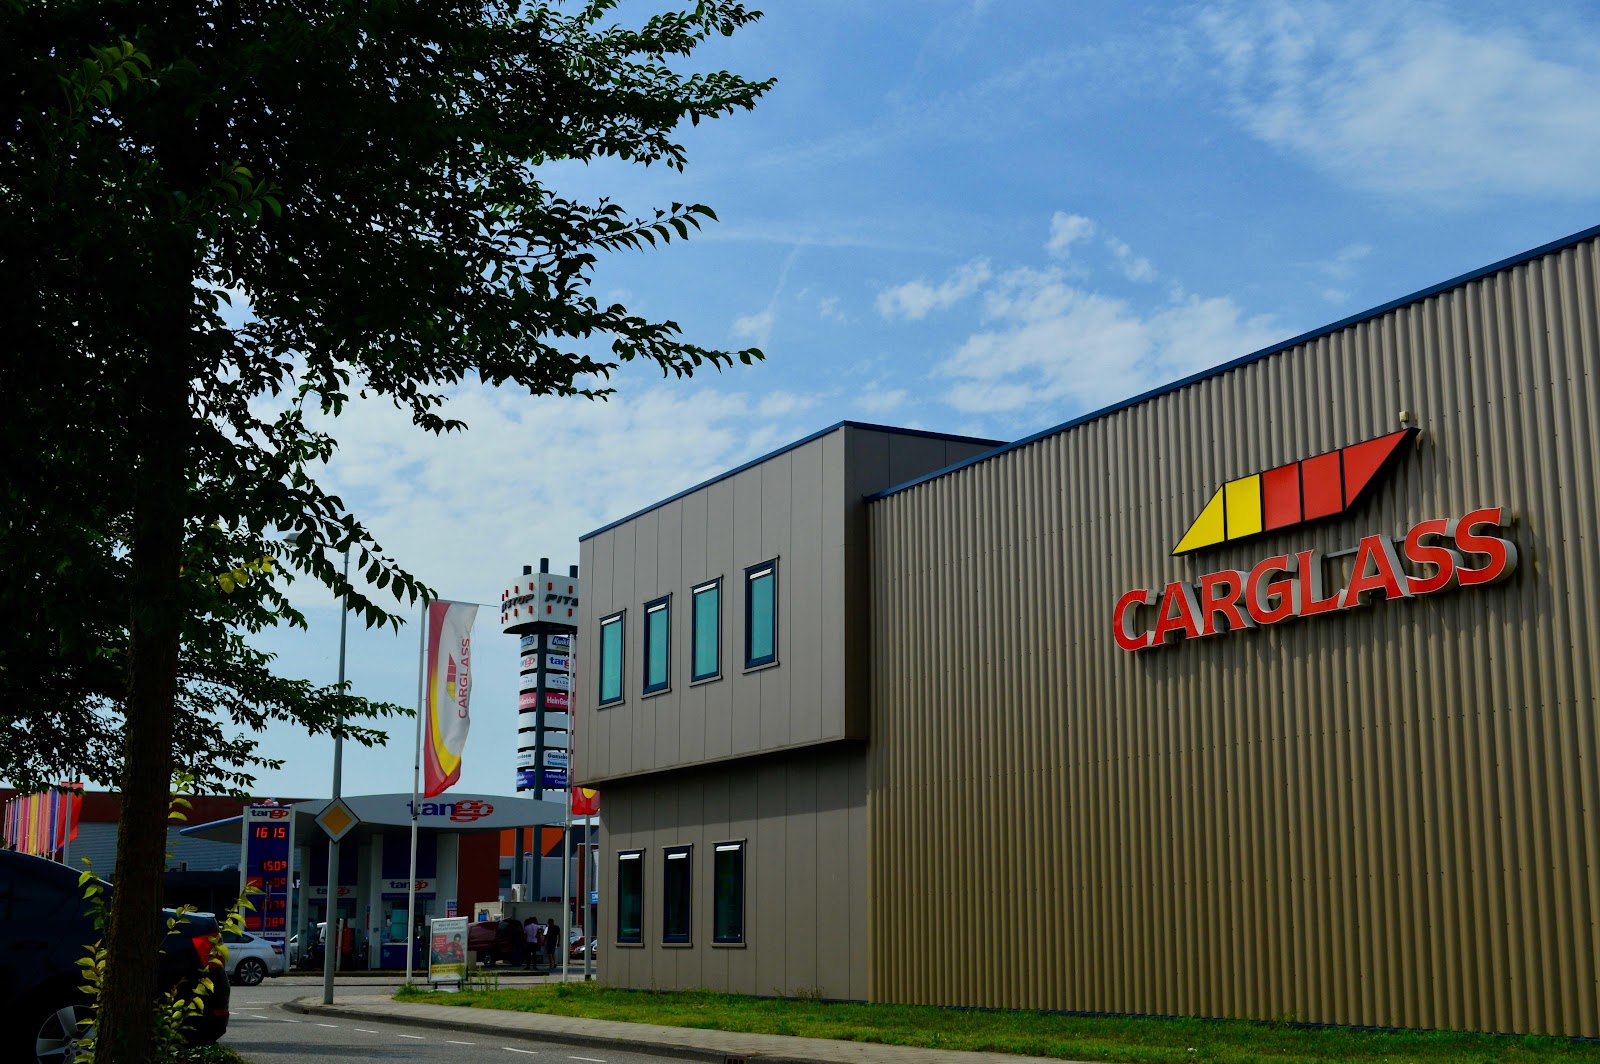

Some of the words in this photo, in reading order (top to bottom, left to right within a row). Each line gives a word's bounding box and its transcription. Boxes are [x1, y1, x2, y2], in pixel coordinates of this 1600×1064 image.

[1112, 506, 1517, 651] CARGLASS
[458, 638, 470, 719] CARGLASS
[251, 809, 289, 819] tango
[406, 800, 494, 823] tango
[316, 887, 350, 897] tago
